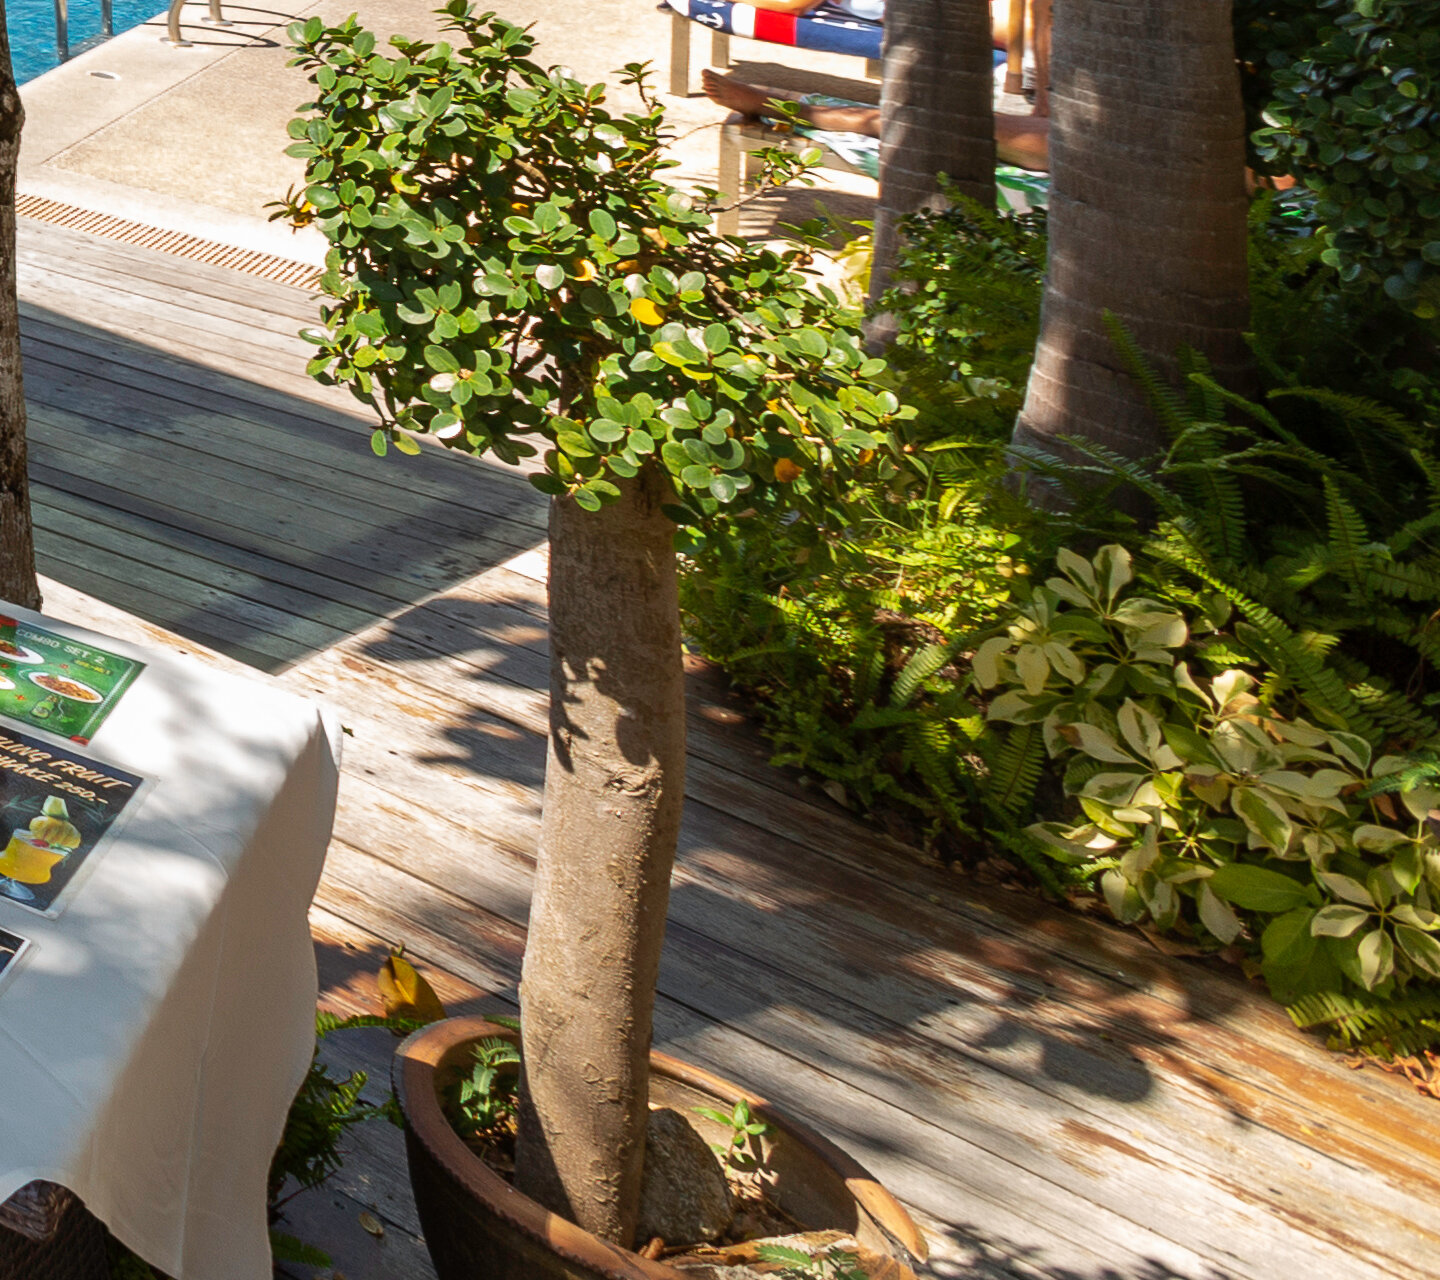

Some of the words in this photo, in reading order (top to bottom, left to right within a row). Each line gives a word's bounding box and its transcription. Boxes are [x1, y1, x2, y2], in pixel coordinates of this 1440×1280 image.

[16, 628, 59, 648] COMBO
[63, 645, 91, 658] SET
[94, 654, 106, 664] 2
[48, 760, 132, 788] FRUIT
[54, 781, 109, 804] 250.-
